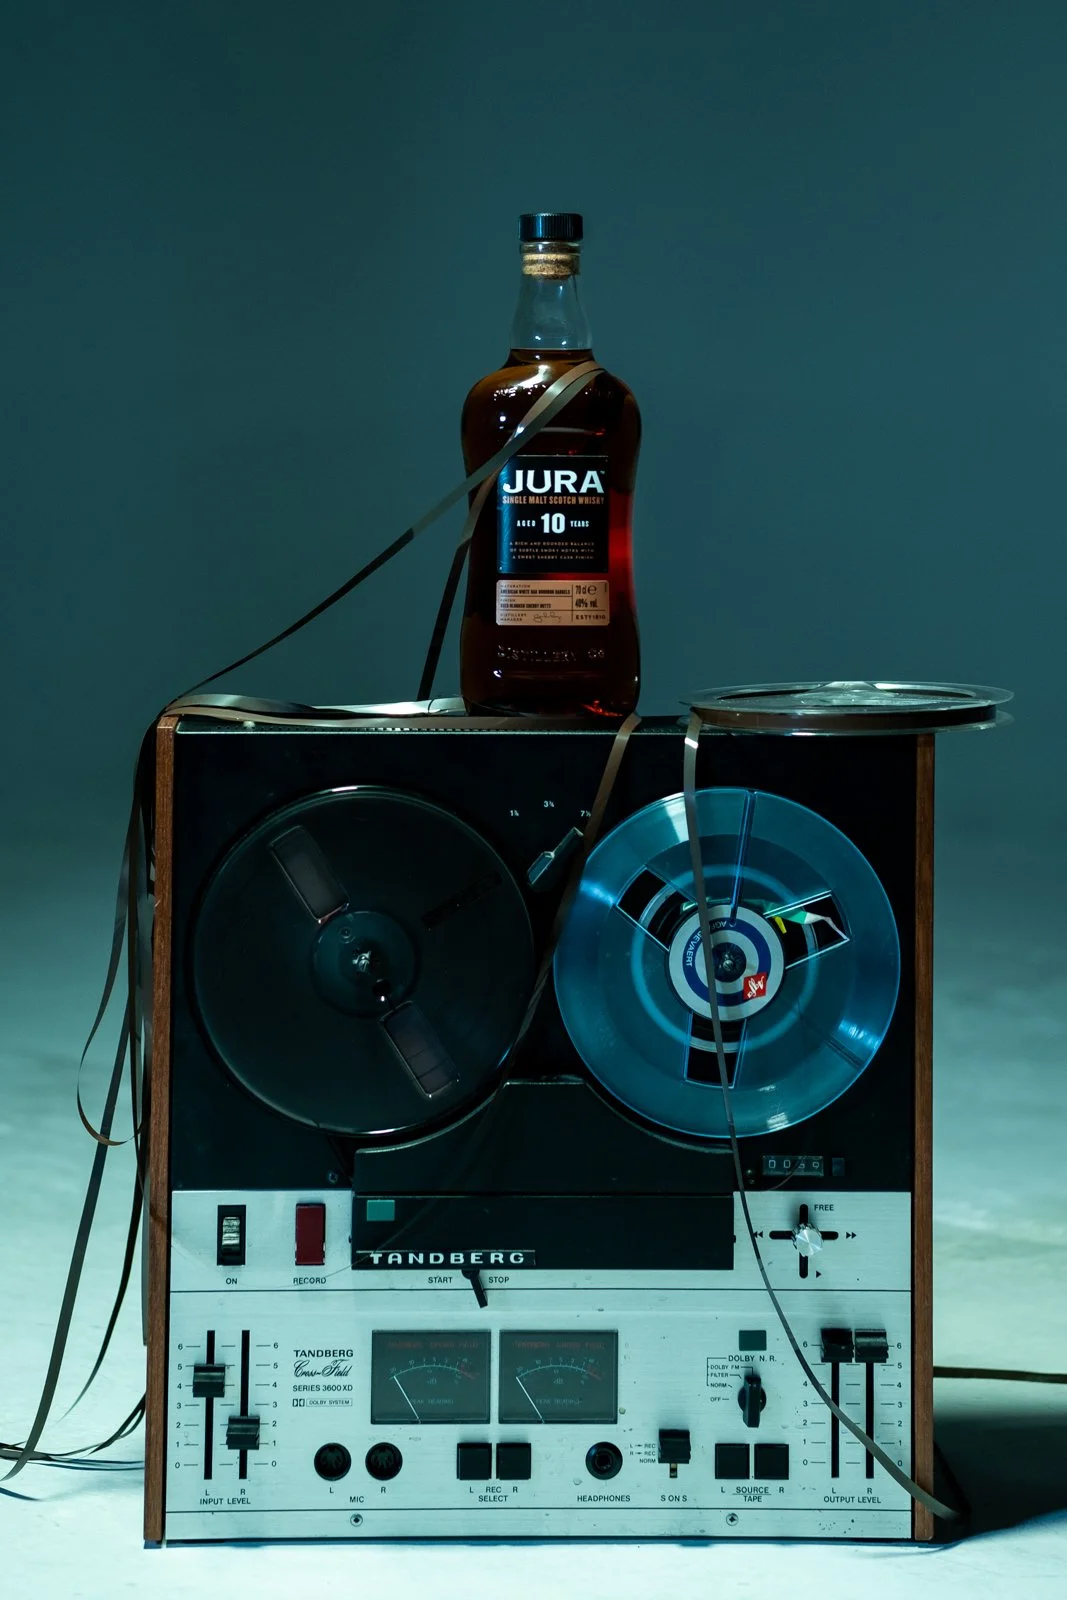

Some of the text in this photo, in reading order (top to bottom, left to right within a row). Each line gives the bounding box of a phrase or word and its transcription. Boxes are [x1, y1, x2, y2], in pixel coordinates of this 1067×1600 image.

[502, 470, 604, 494] JURA
[502, 496, 604, 504] SINGLE MALT SCOTCH WHISKY
[541, 513, 566, 534] 10
[576, 585, 581, 594] 70
[370, 1252, 525, 1265] TANDBERG
[428, 1276, 453, 1284] START
[488, 1276, 510, 1284] STOP
